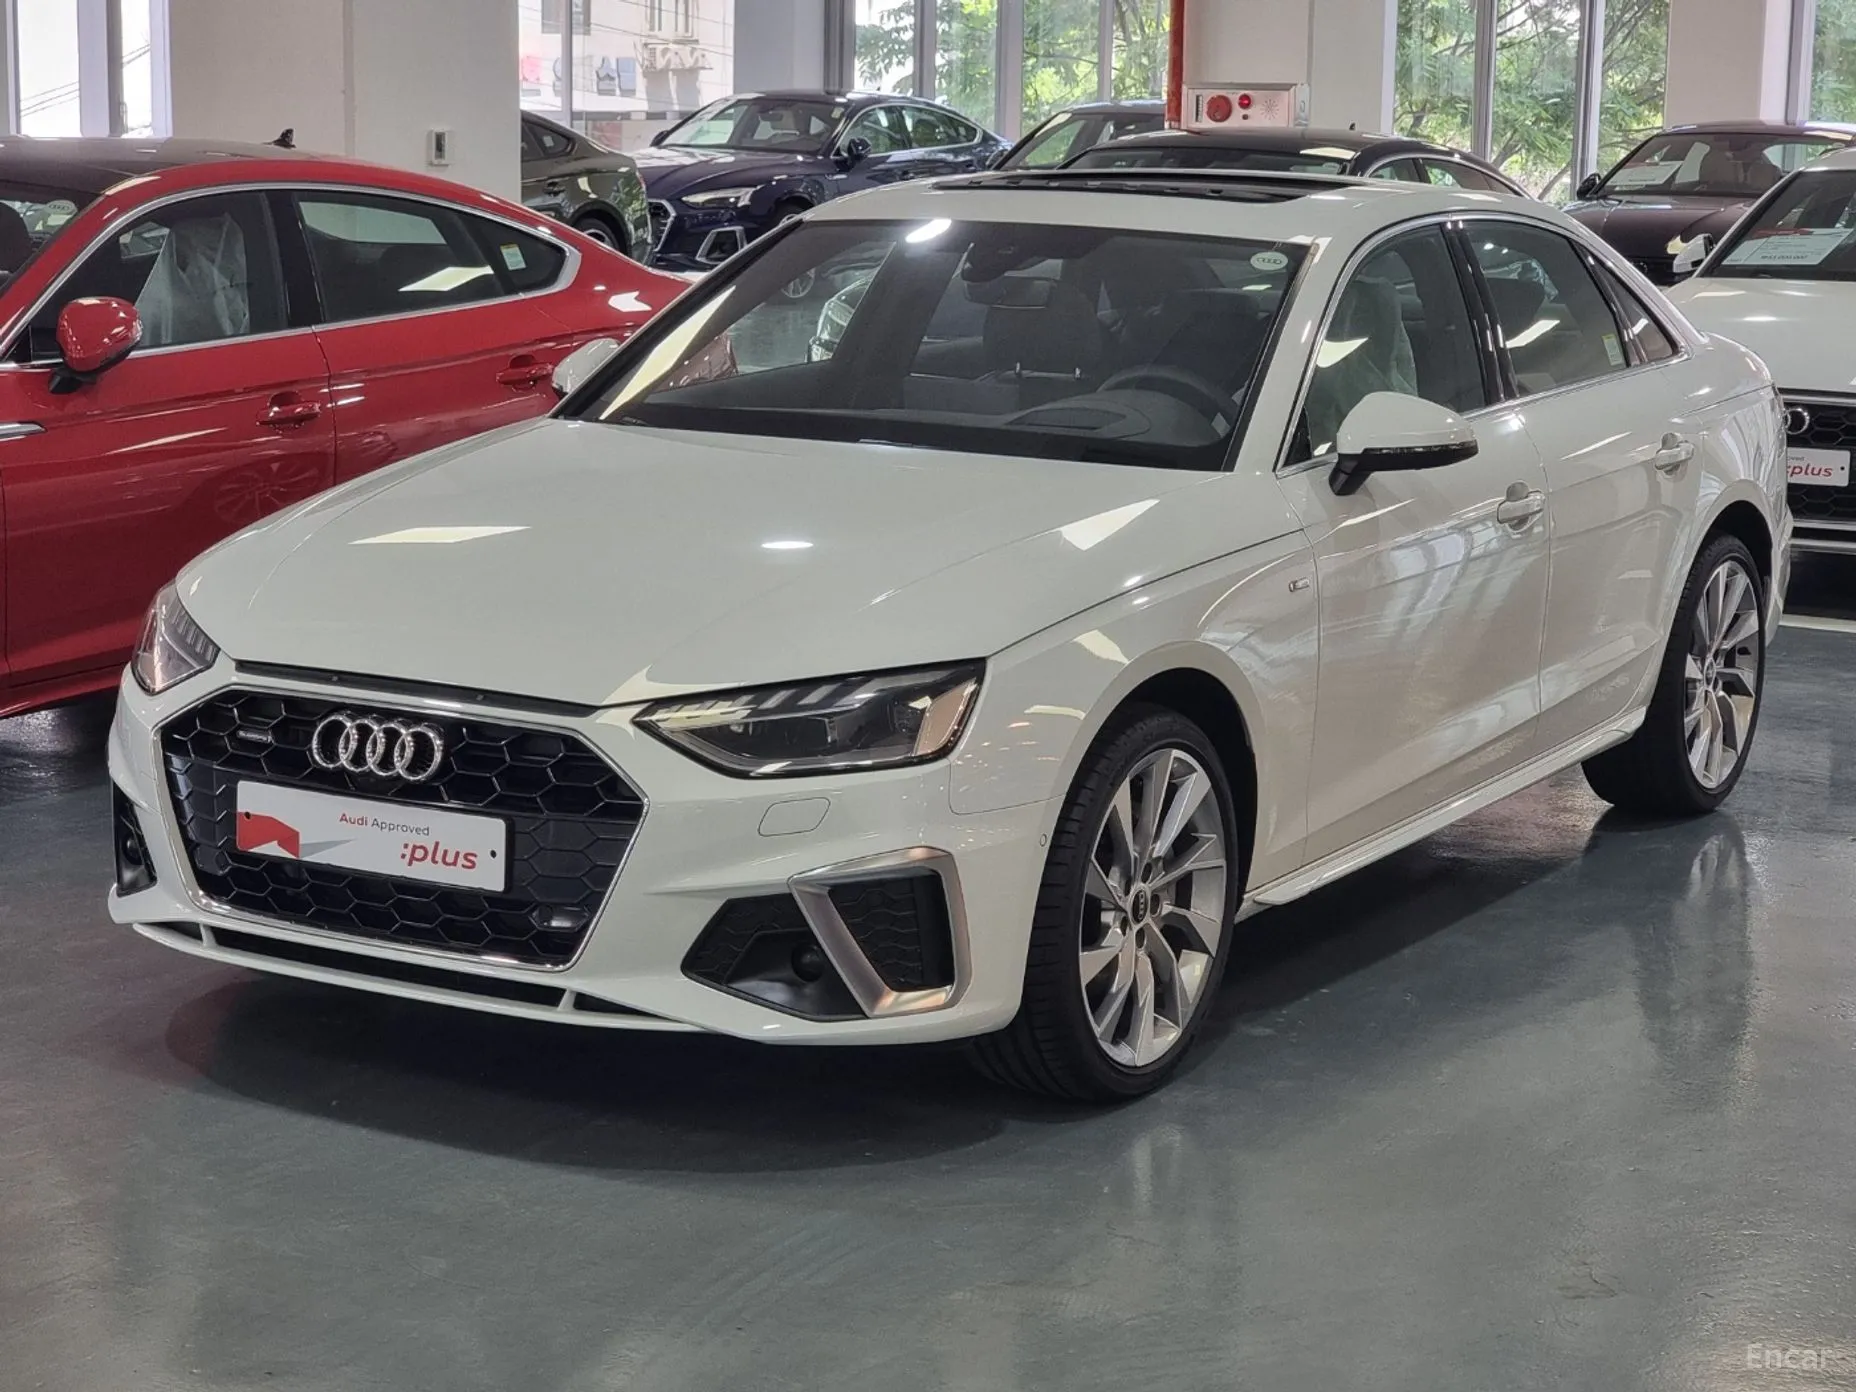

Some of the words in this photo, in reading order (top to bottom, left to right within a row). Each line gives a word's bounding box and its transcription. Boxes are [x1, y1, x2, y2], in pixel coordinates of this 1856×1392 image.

[339, 813, 368, 826] Audi
[371, 818, 430, 836] Approved
[400, 841, 478, 869] :plus
